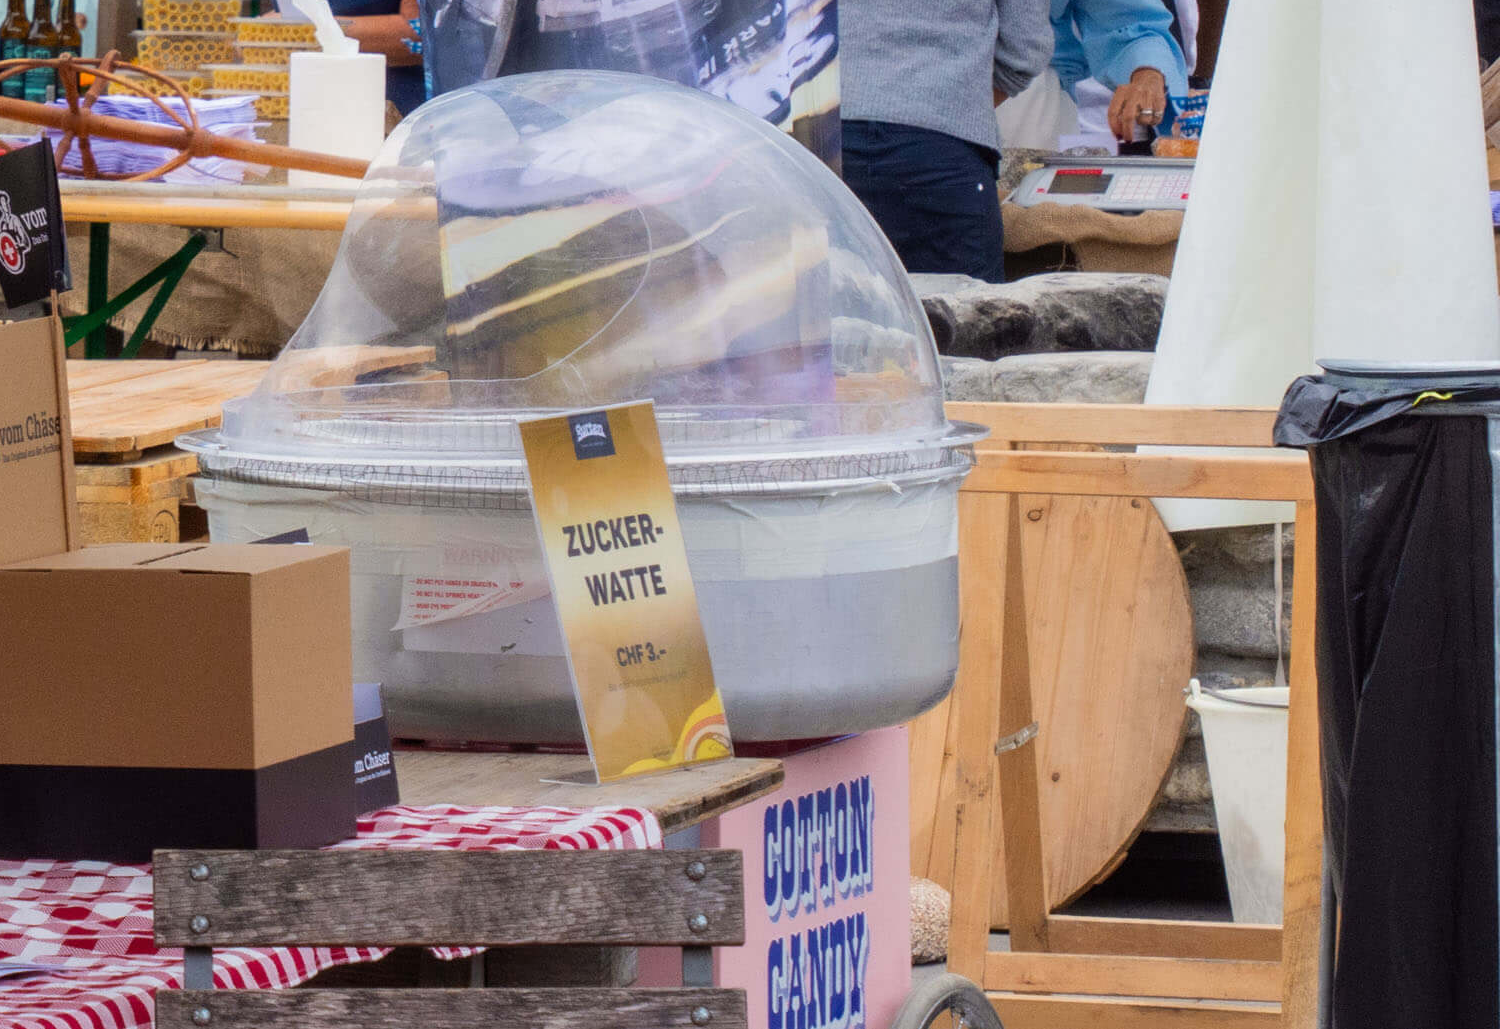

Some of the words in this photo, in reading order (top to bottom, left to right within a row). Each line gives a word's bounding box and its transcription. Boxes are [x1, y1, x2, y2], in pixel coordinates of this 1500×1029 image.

[0, 424, 25, 446] vom
[25, 411, 61, 441] Chäse
[562, 513, 665, 558] ZUCKER-
[585, 564, 668, 607] WATTE
[616, 643, 644, 667] CHF
[645, 641, 668, 662] 3.-
[764, 774, 875, 922] COTTON
[768, 912, 870, 1029] CANDY
